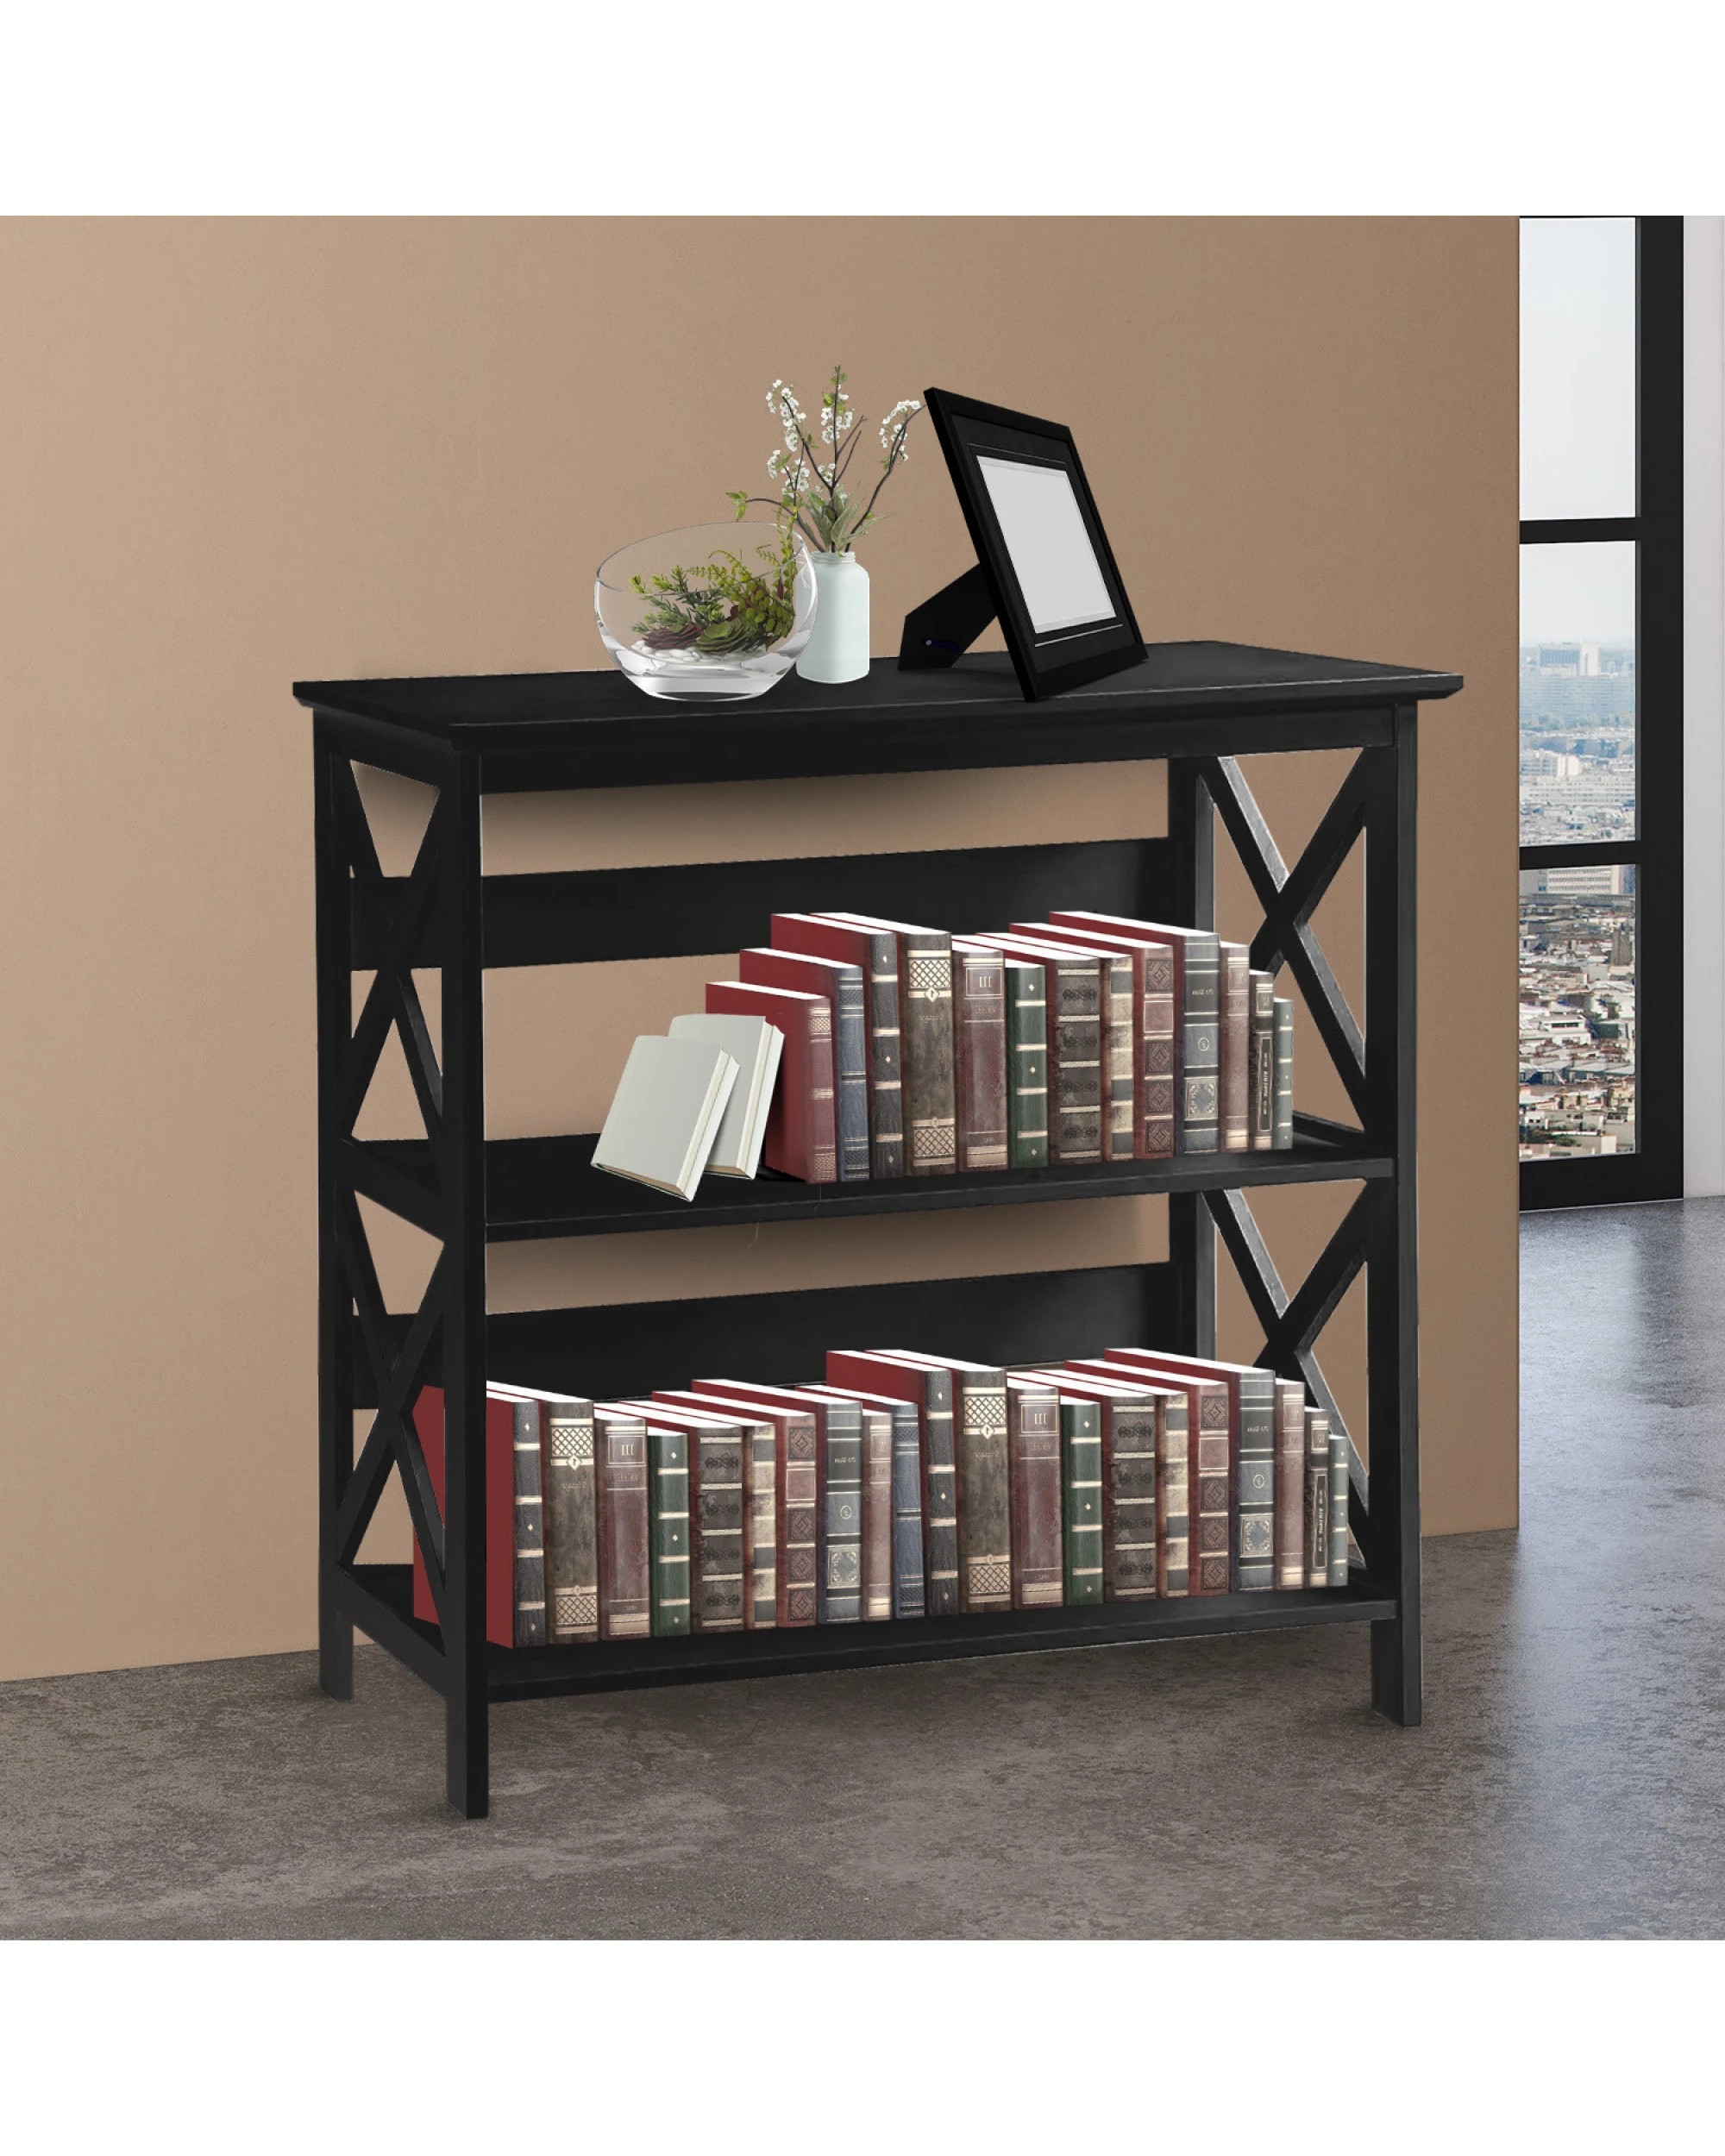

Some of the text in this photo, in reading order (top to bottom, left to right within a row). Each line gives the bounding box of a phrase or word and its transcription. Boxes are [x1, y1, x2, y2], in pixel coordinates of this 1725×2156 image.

[979, 976, 992, 988] III
[1034, 1413, 1047, 1425] III
[621, 1444, 635, 1456] III
